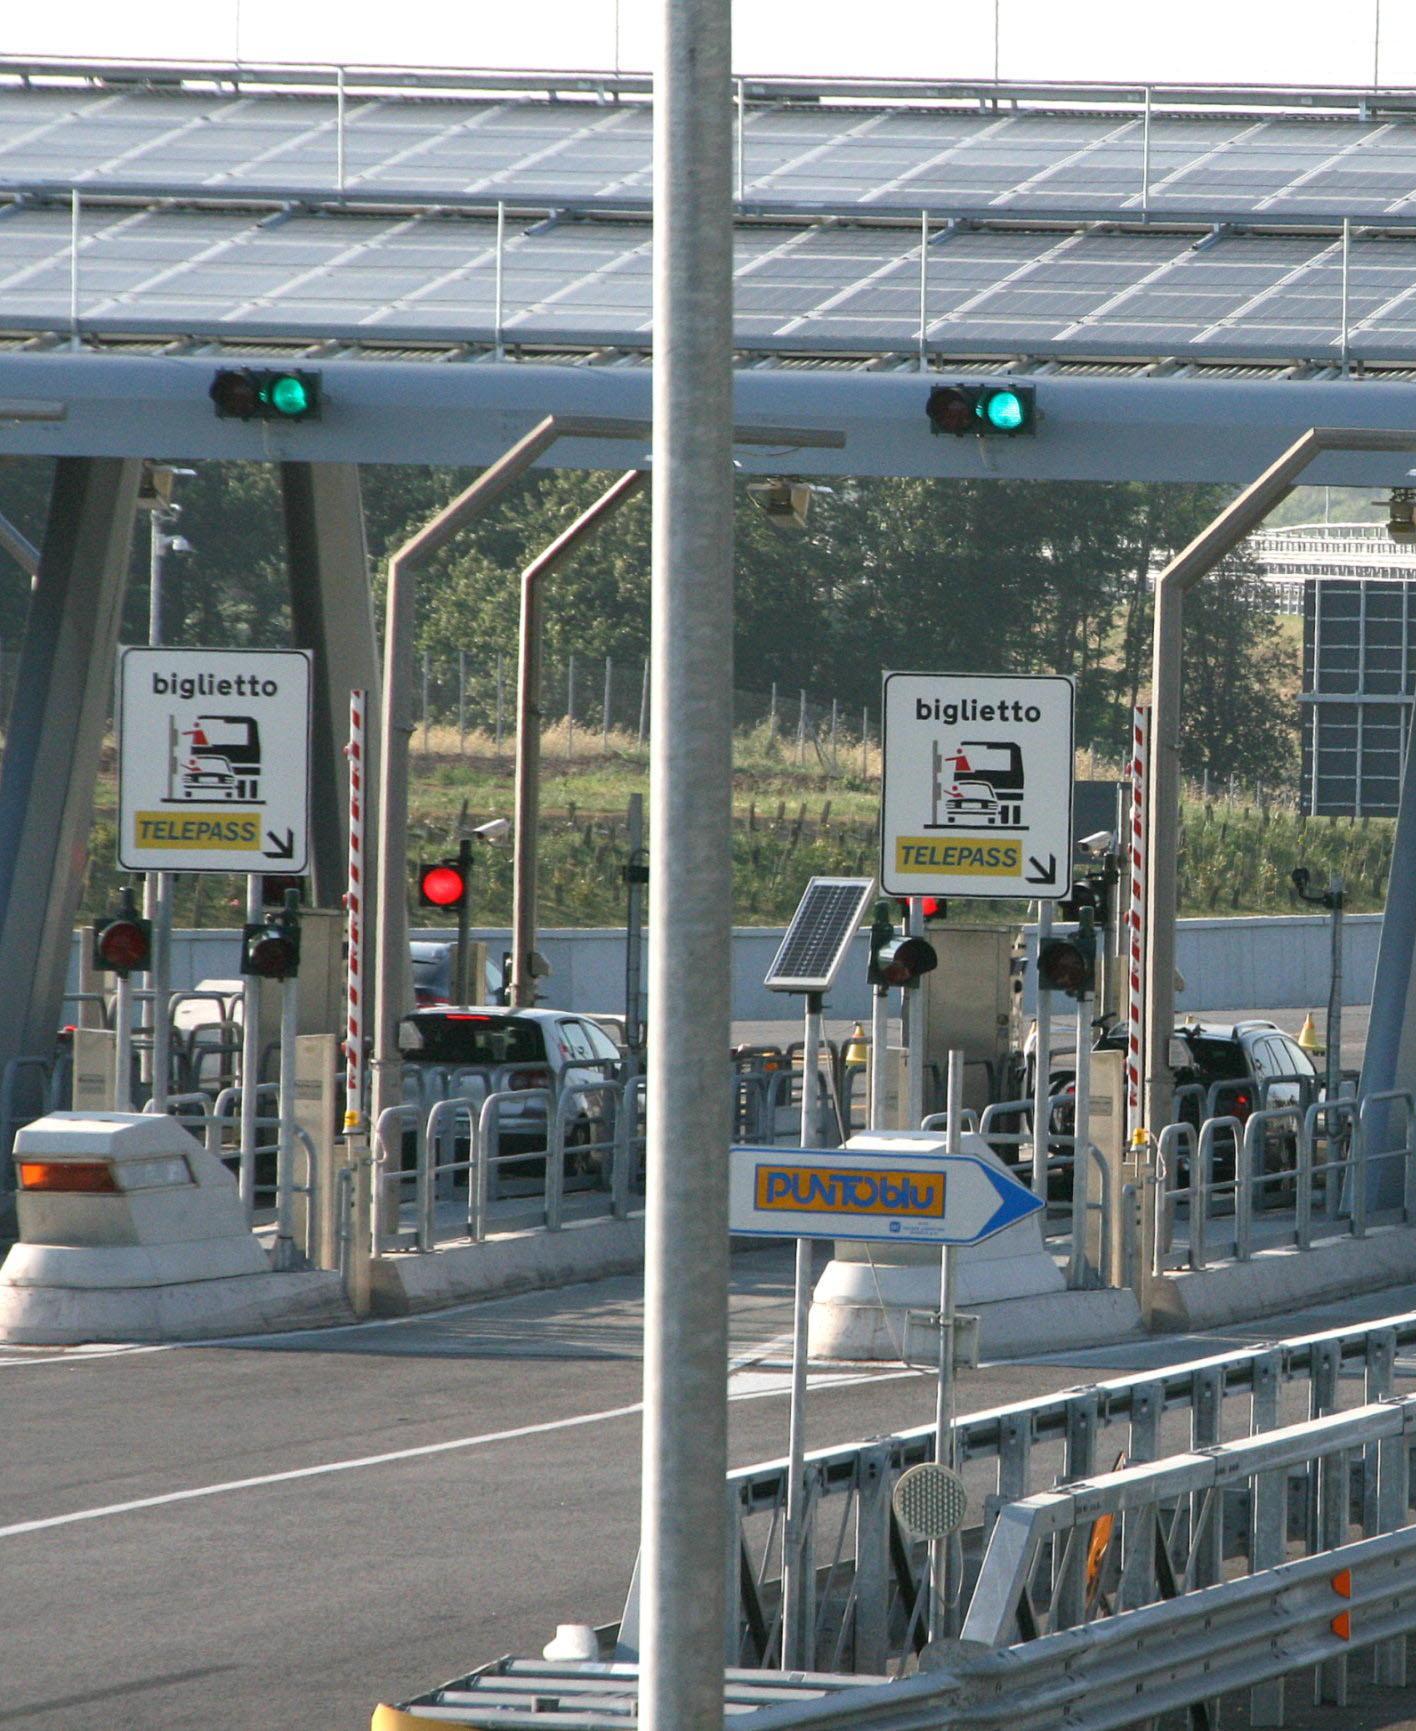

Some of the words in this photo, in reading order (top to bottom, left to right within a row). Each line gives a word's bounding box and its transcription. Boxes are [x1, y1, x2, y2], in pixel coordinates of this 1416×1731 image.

[152, 672, 278, 699] biglietto
[916, 698, 1041, 725] biglietto
[139, 820, 257, 842] TELEPASS
[901, 845, 1017, 868] TELEPASS
